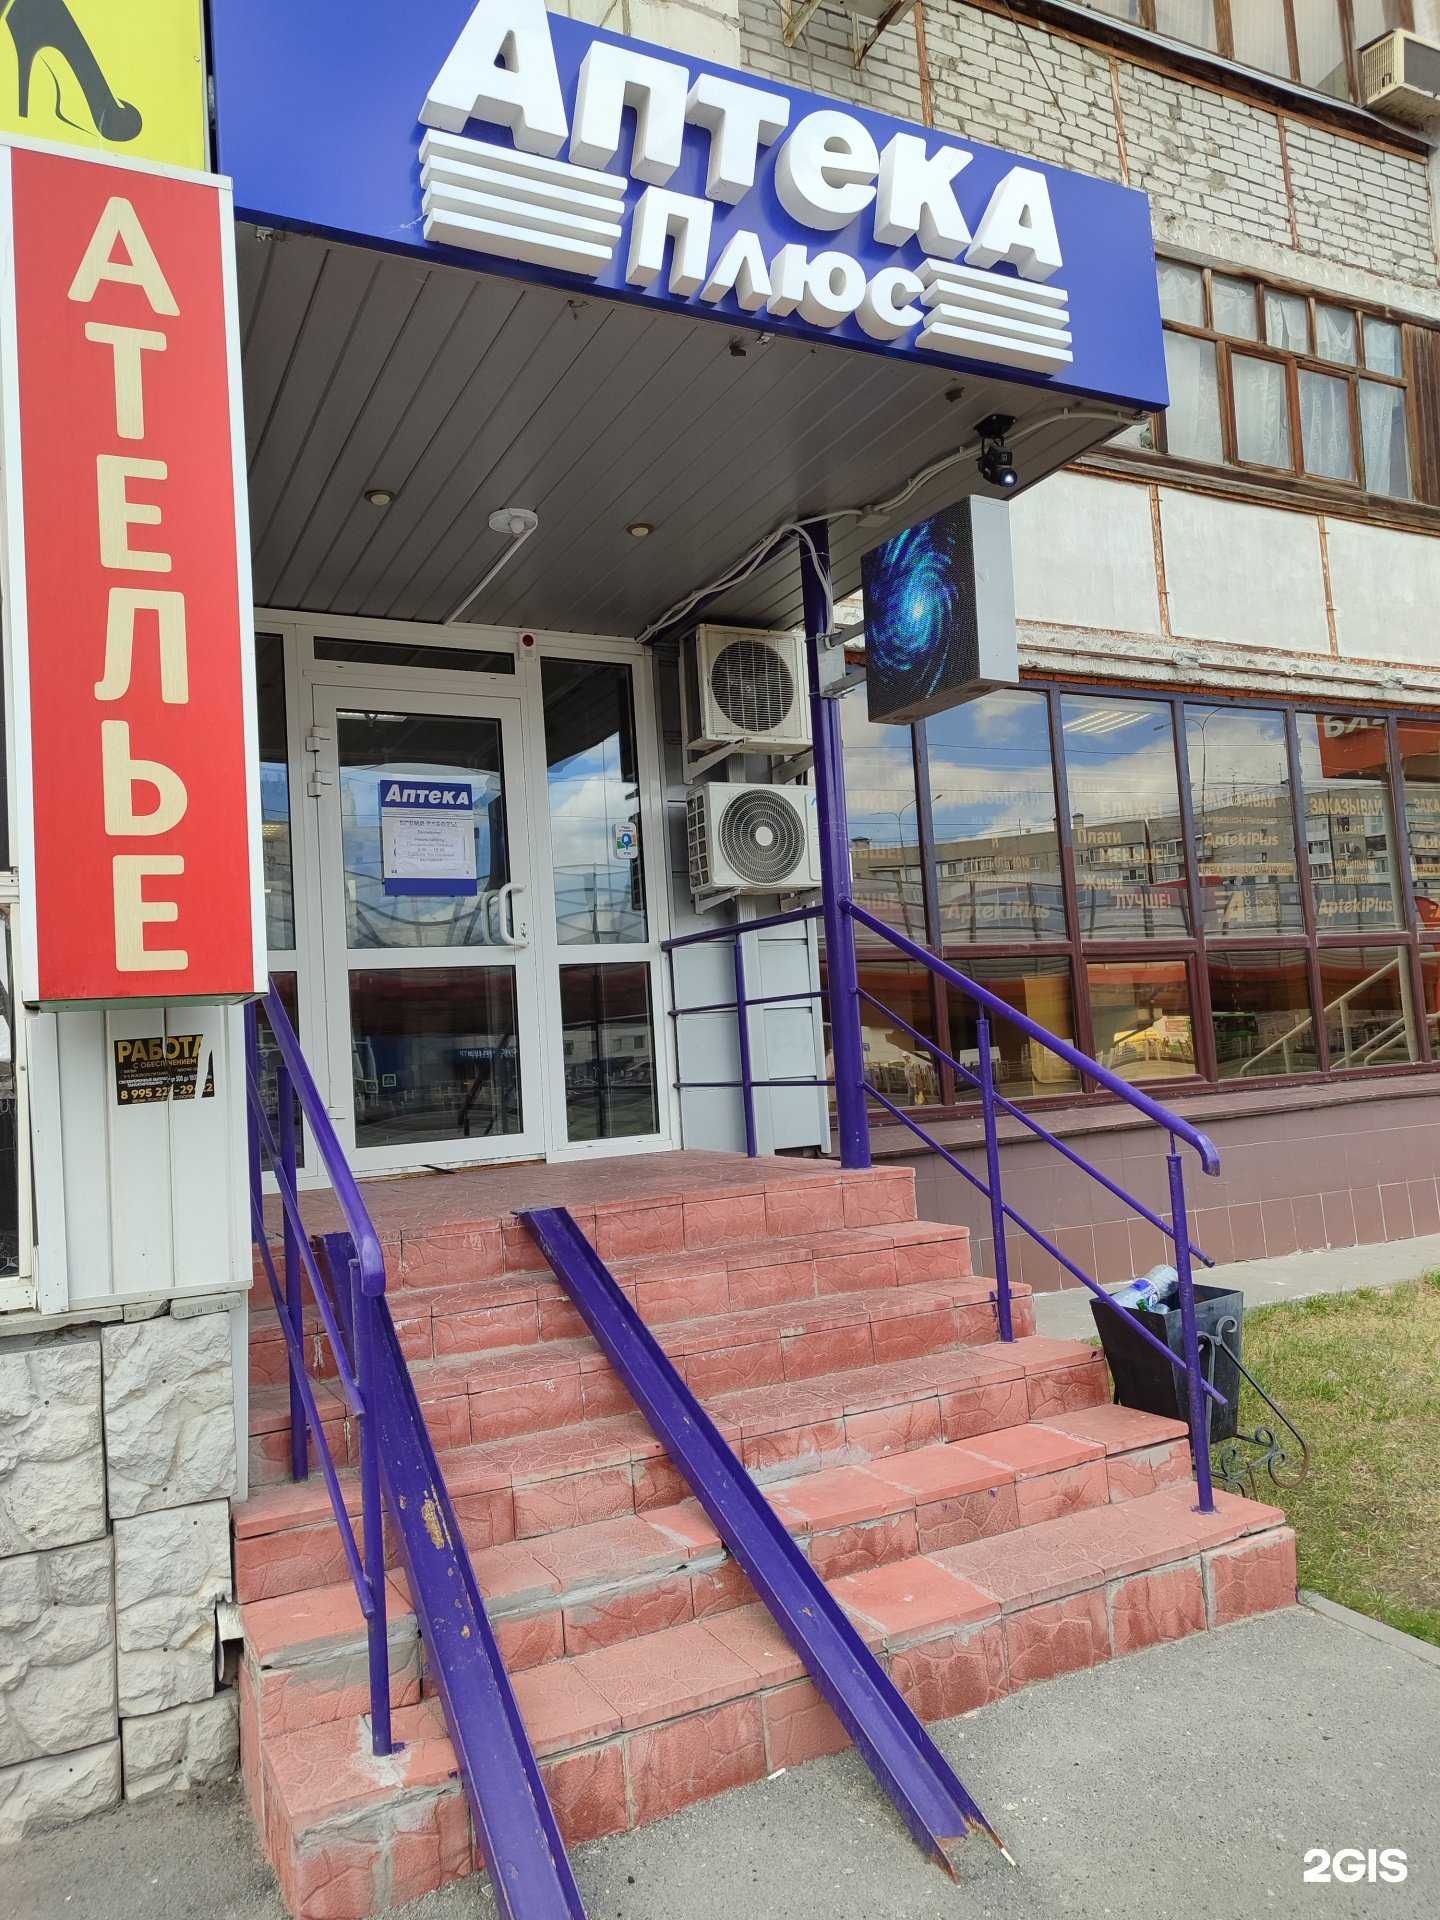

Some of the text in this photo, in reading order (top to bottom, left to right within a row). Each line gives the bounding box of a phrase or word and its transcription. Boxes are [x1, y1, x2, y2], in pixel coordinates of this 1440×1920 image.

[67, 196, 189, 973] АТЕЛЬЕ
[1115, 893, 1171, 910] ЛУЧШЕ!
[1318, 896, 1393, 917] AptekiPlus
[120, 1090, 129, 1100] 8
[131, 1088, 153, 1099] 995
